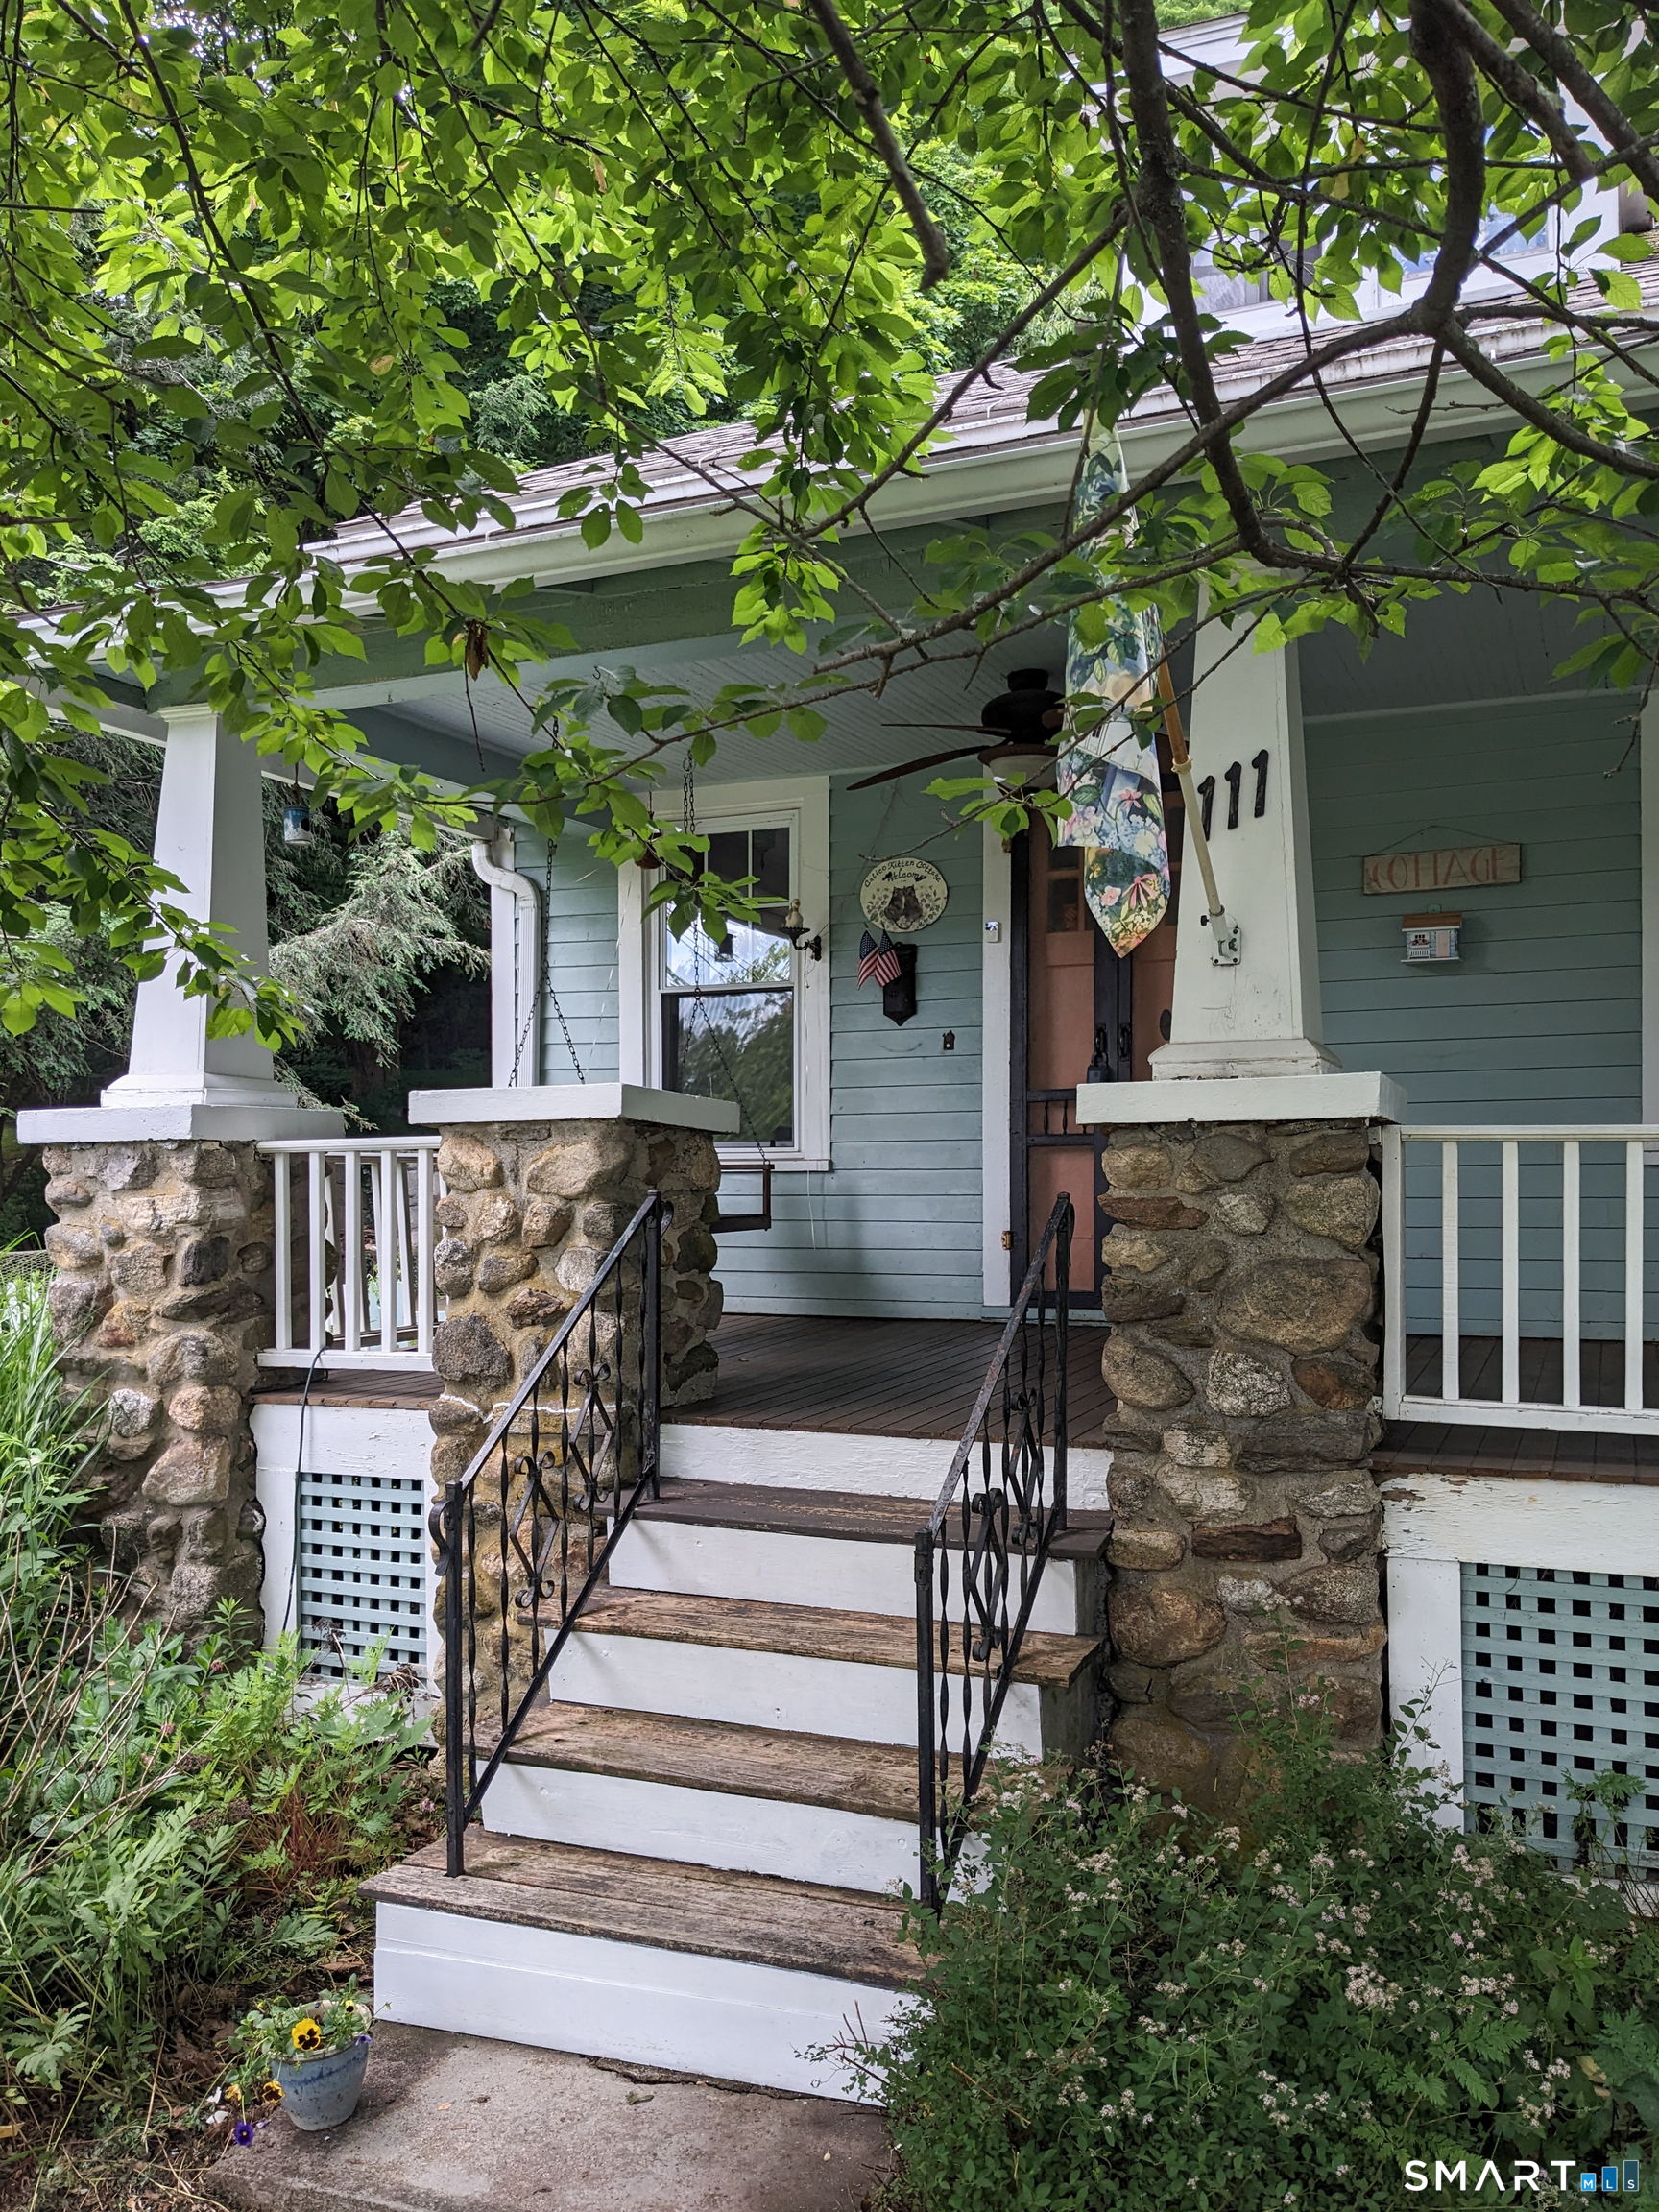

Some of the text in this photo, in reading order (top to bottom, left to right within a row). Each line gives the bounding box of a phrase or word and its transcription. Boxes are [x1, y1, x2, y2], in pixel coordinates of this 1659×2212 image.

[1197, 749, 1269, 842] 111
[887, 860, 915, 870] Kitten
[1372, 848, 1509, 890] COTTAGE
